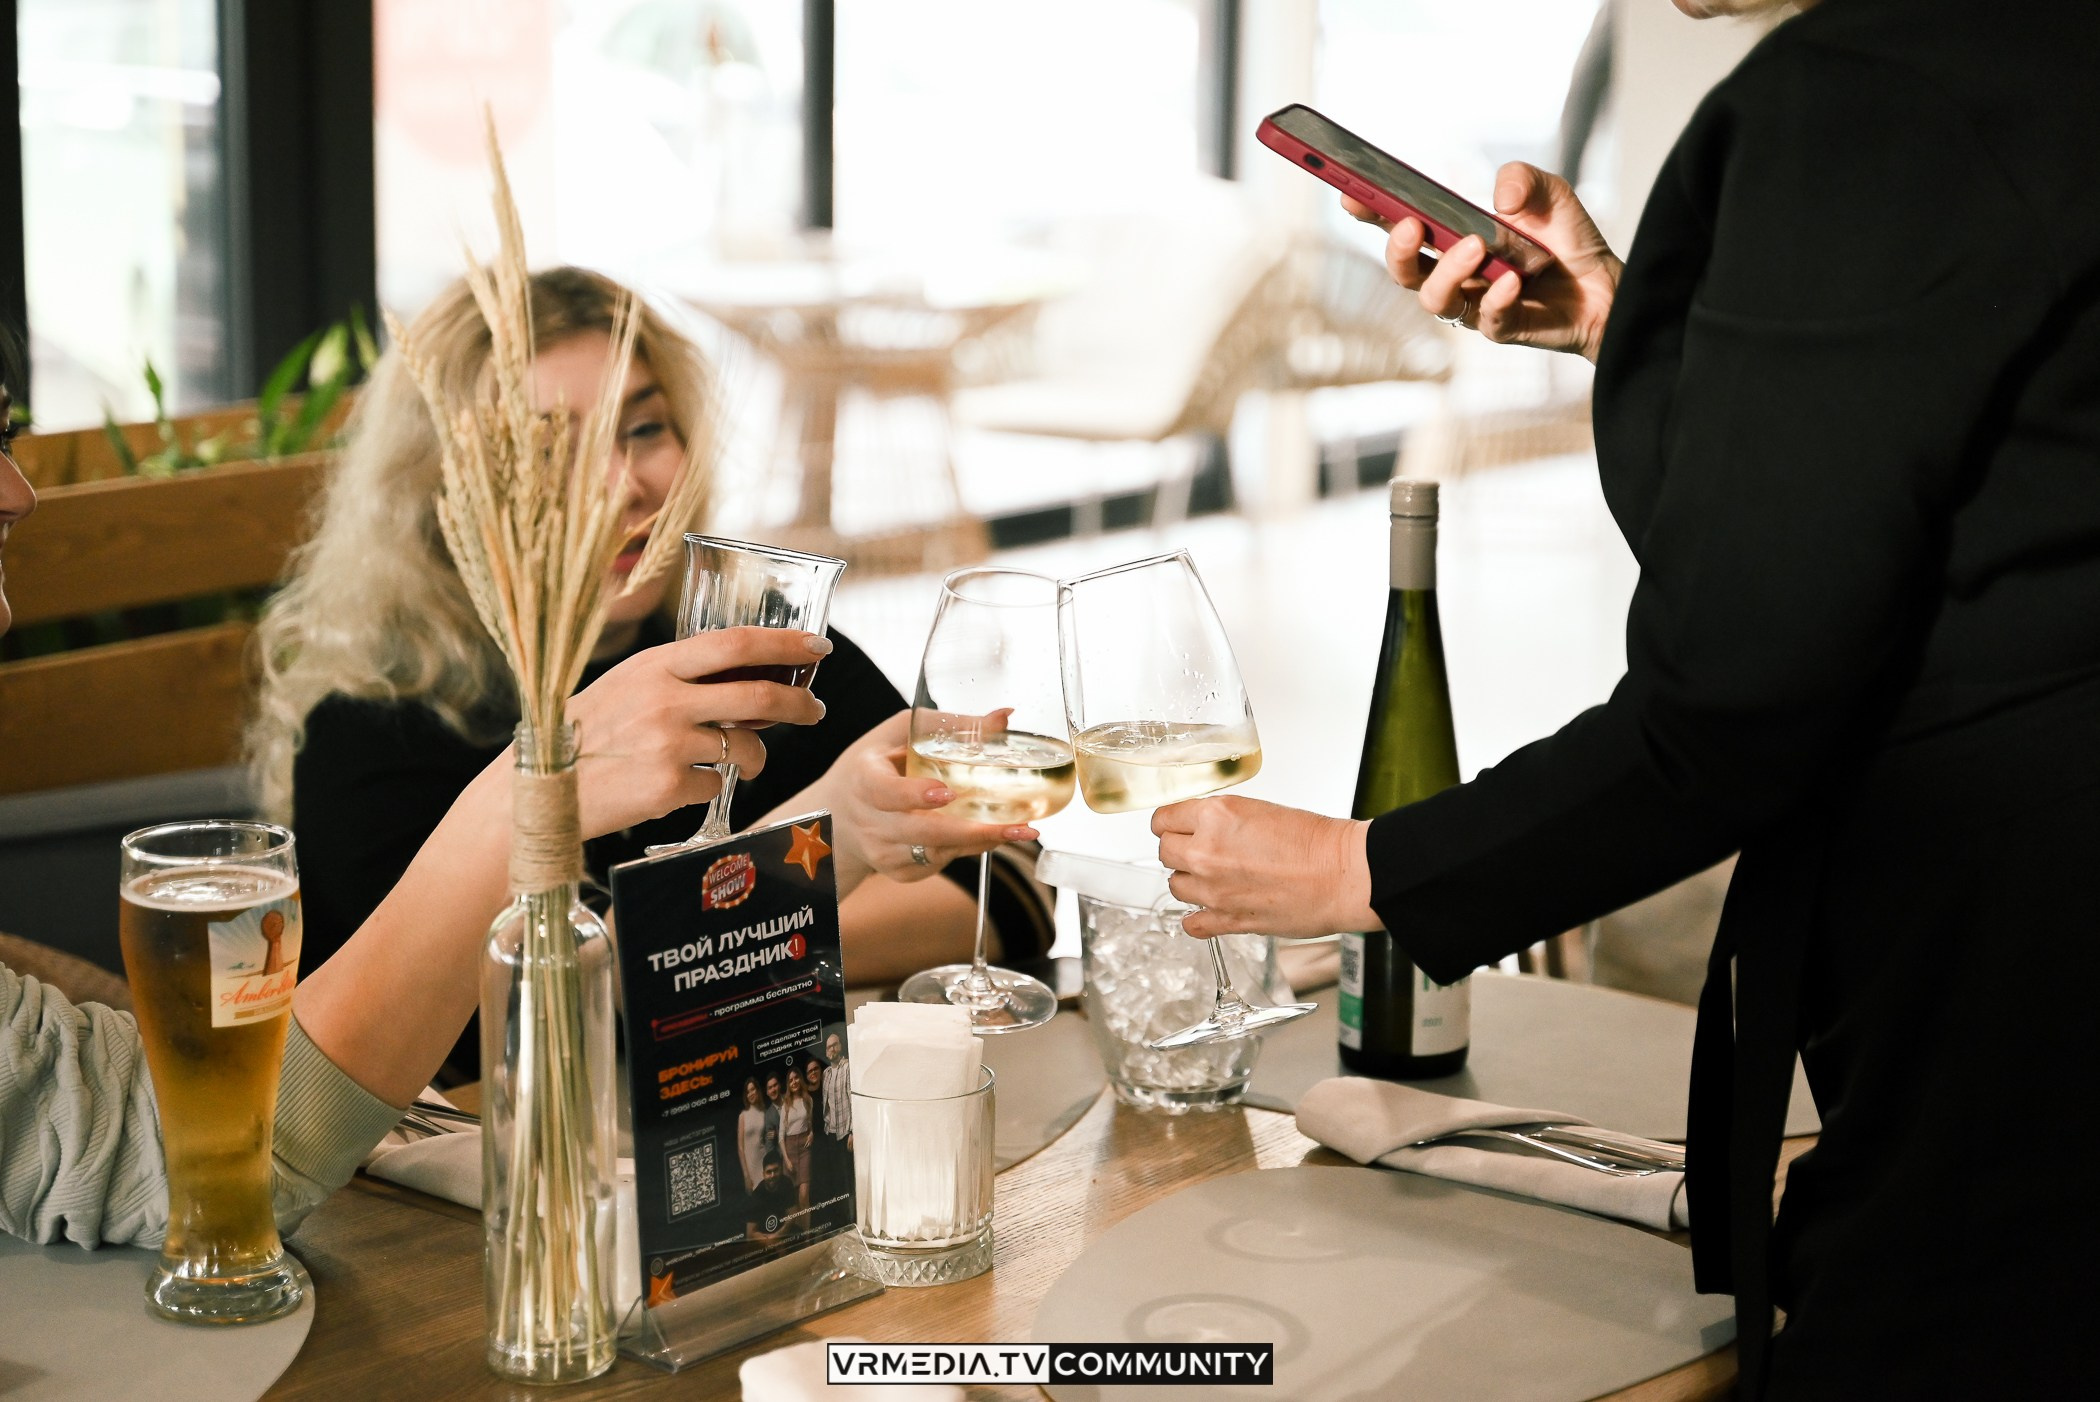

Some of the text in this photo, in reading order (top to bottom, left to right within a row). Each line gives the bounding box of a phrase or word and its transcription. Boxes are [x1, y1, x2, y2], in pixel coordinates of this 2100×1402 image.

[709, 855, 747, 884] WELCOME
[711, 873, 746, 904] SHOW
[648, 904, 814, 972] ТВОЙ ЛУЧШИЙ
[674, 937, 799, 992] ПРАЗДНИК!
[714, 995, 764, 1017] программа
[766, 980, 813, 1000] бесплатно
[658, 1046, 738, 1083] БРОНИРУЙ
[660, 1075, 713, 1100] ЗДЕСЬ:
